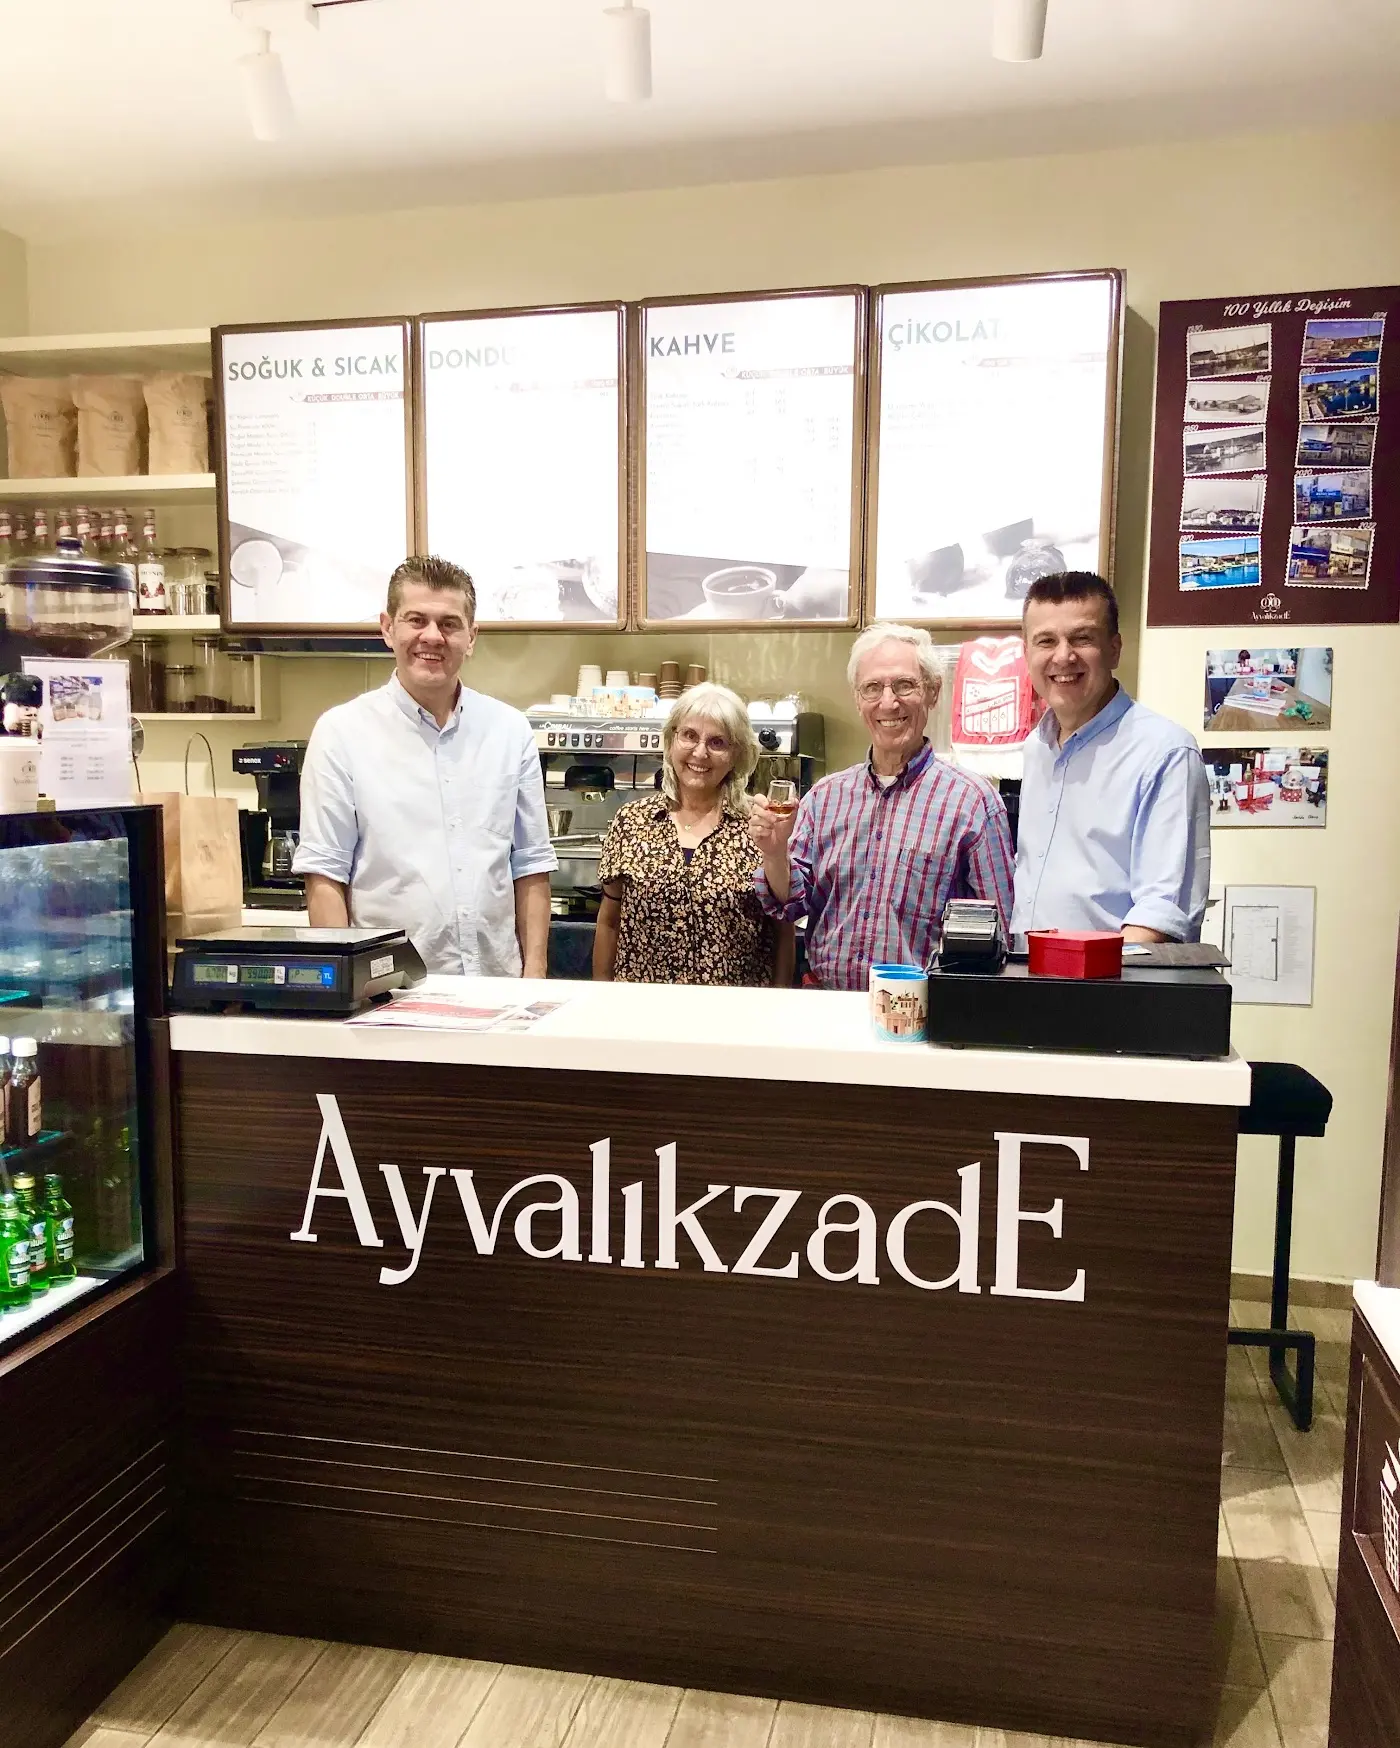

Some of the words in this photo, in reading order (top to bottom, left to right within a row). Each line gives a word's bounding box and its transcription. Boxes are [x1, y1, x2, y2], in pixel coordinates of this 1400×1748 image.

[1223, 302, 1250, 317] 100
[1253, 300, 1291, 319] Yıllık
[1294, 297, 1352, 315] Değişim
[650, 332, 736, 358] KAHVE
[228, 355, 303, 381] SOĞUK
[311, 357, 326, 378] &
[334, 354, 398, 376] SICAK
[289, 1093, 1090, 1302] AyvalıkzadE
